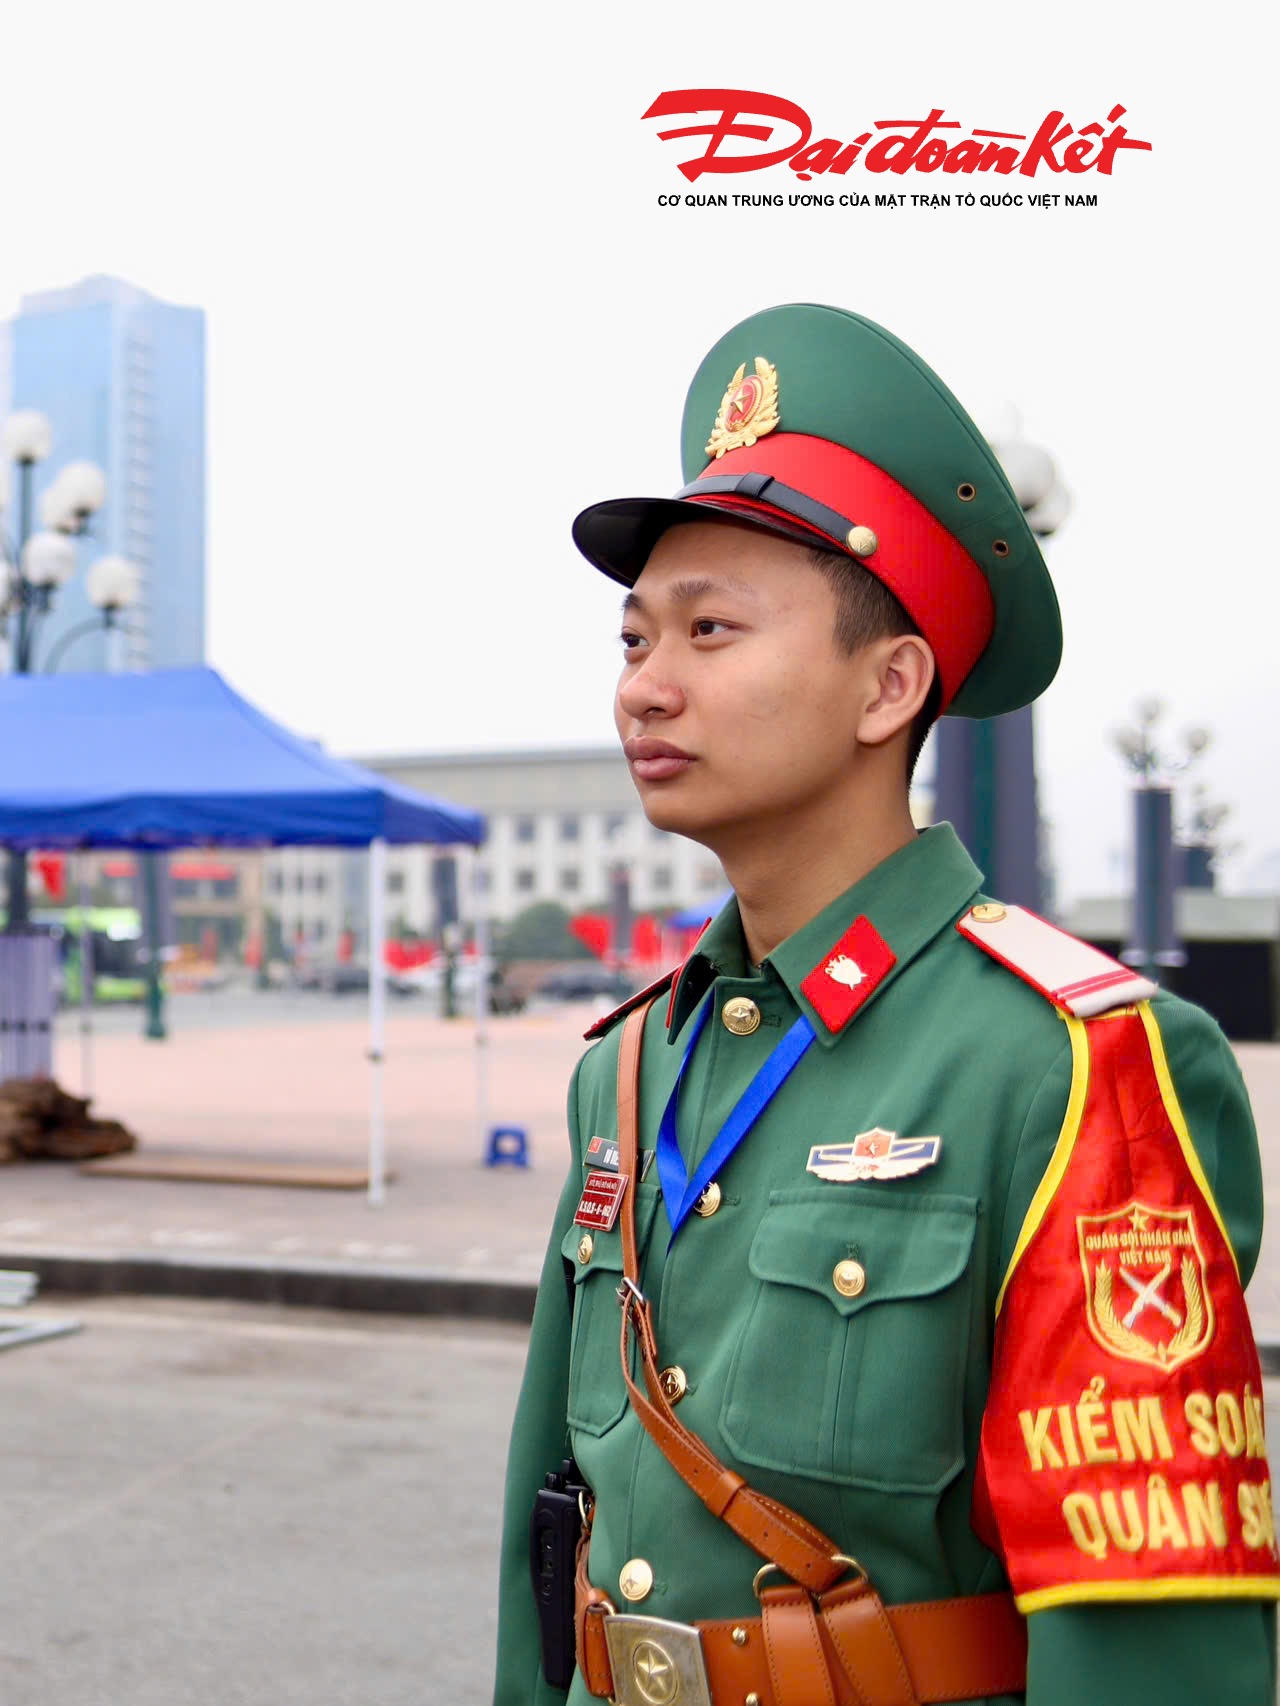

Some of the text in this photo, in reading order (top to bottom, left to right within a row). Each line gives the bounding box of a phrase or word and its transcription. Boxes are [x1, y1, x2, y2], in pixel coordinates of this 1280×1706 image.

[1119, 1248, 1172, 1267] VIỆT NAM
[1018, 1376, 1268, 1471] KIỂM SOÁ
[1061, 1473, 1227, 1559] QUÂN
